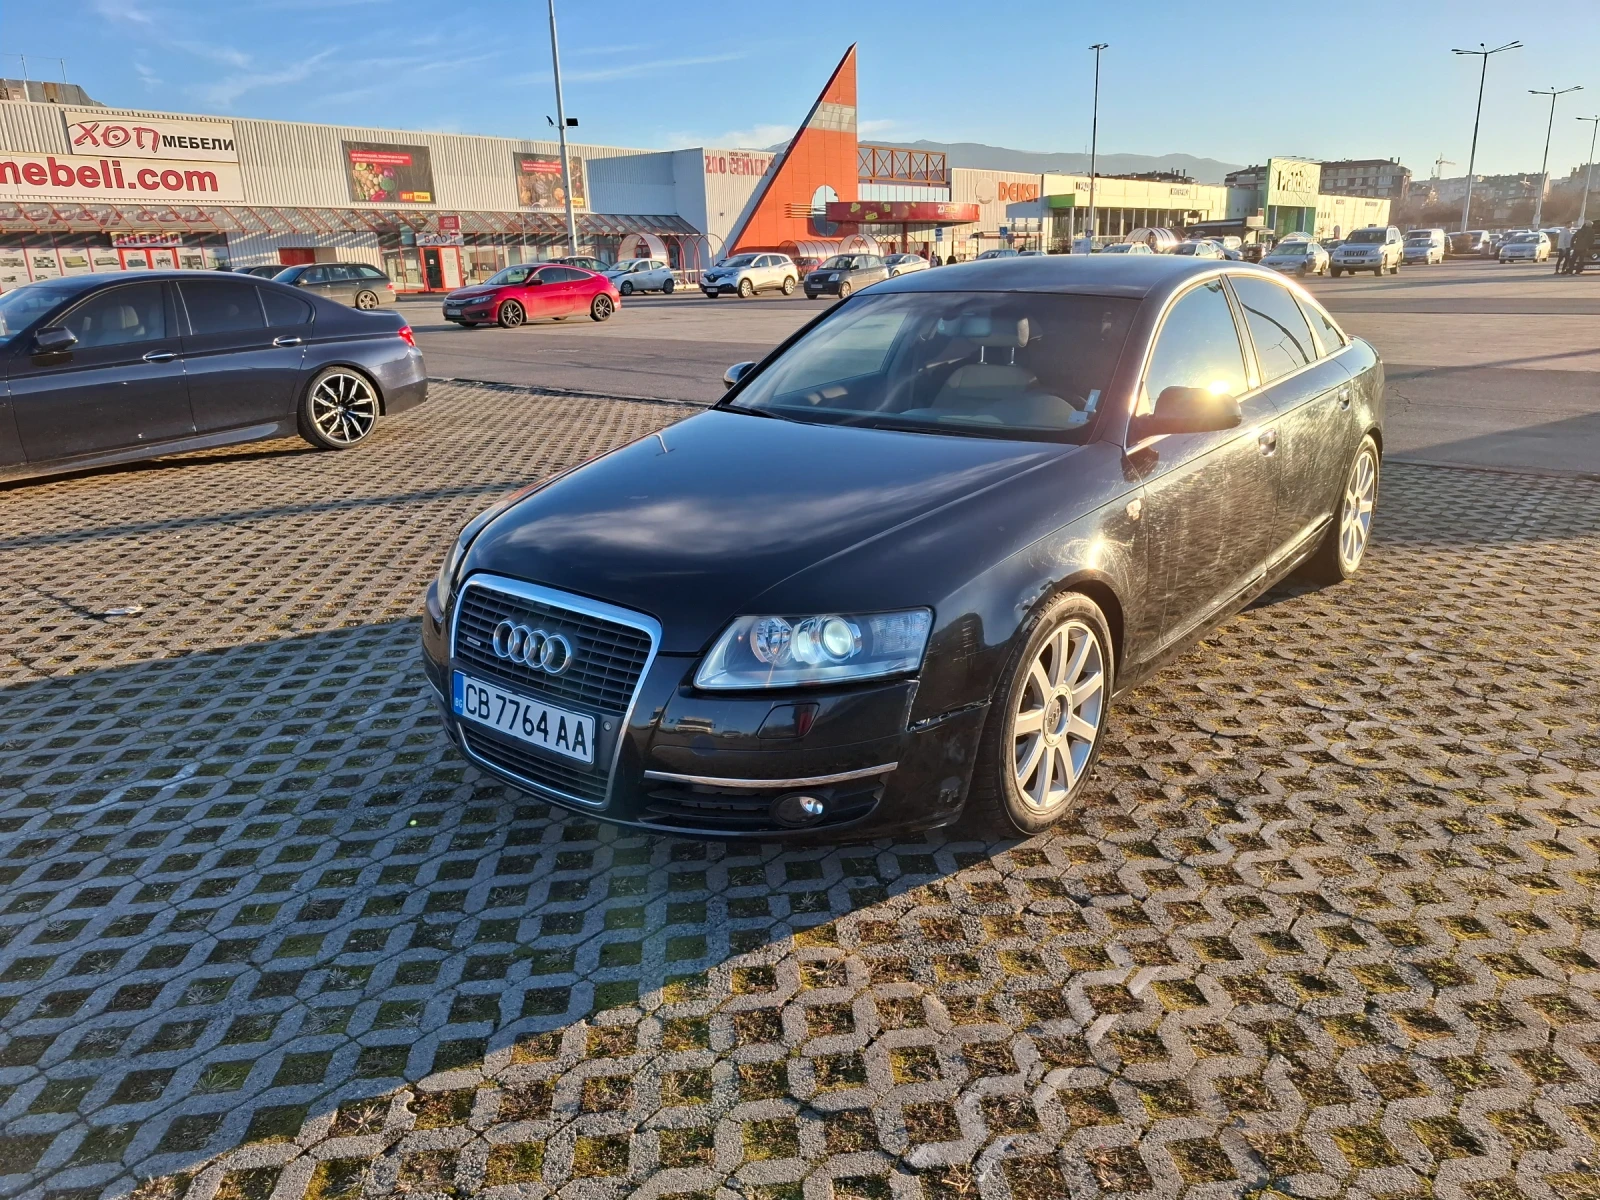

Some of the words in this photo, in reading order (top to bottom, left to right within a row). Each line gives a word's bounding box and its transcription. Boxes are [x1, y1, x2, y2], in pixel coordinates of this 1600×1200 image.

[73, 122, 160, 153] ХОП
[162, 135, 235, 151] МЕБЕЛИ
[115, 233, 180, 246] ДНЕВНИ
[495, 694, 549, 742] 7764
